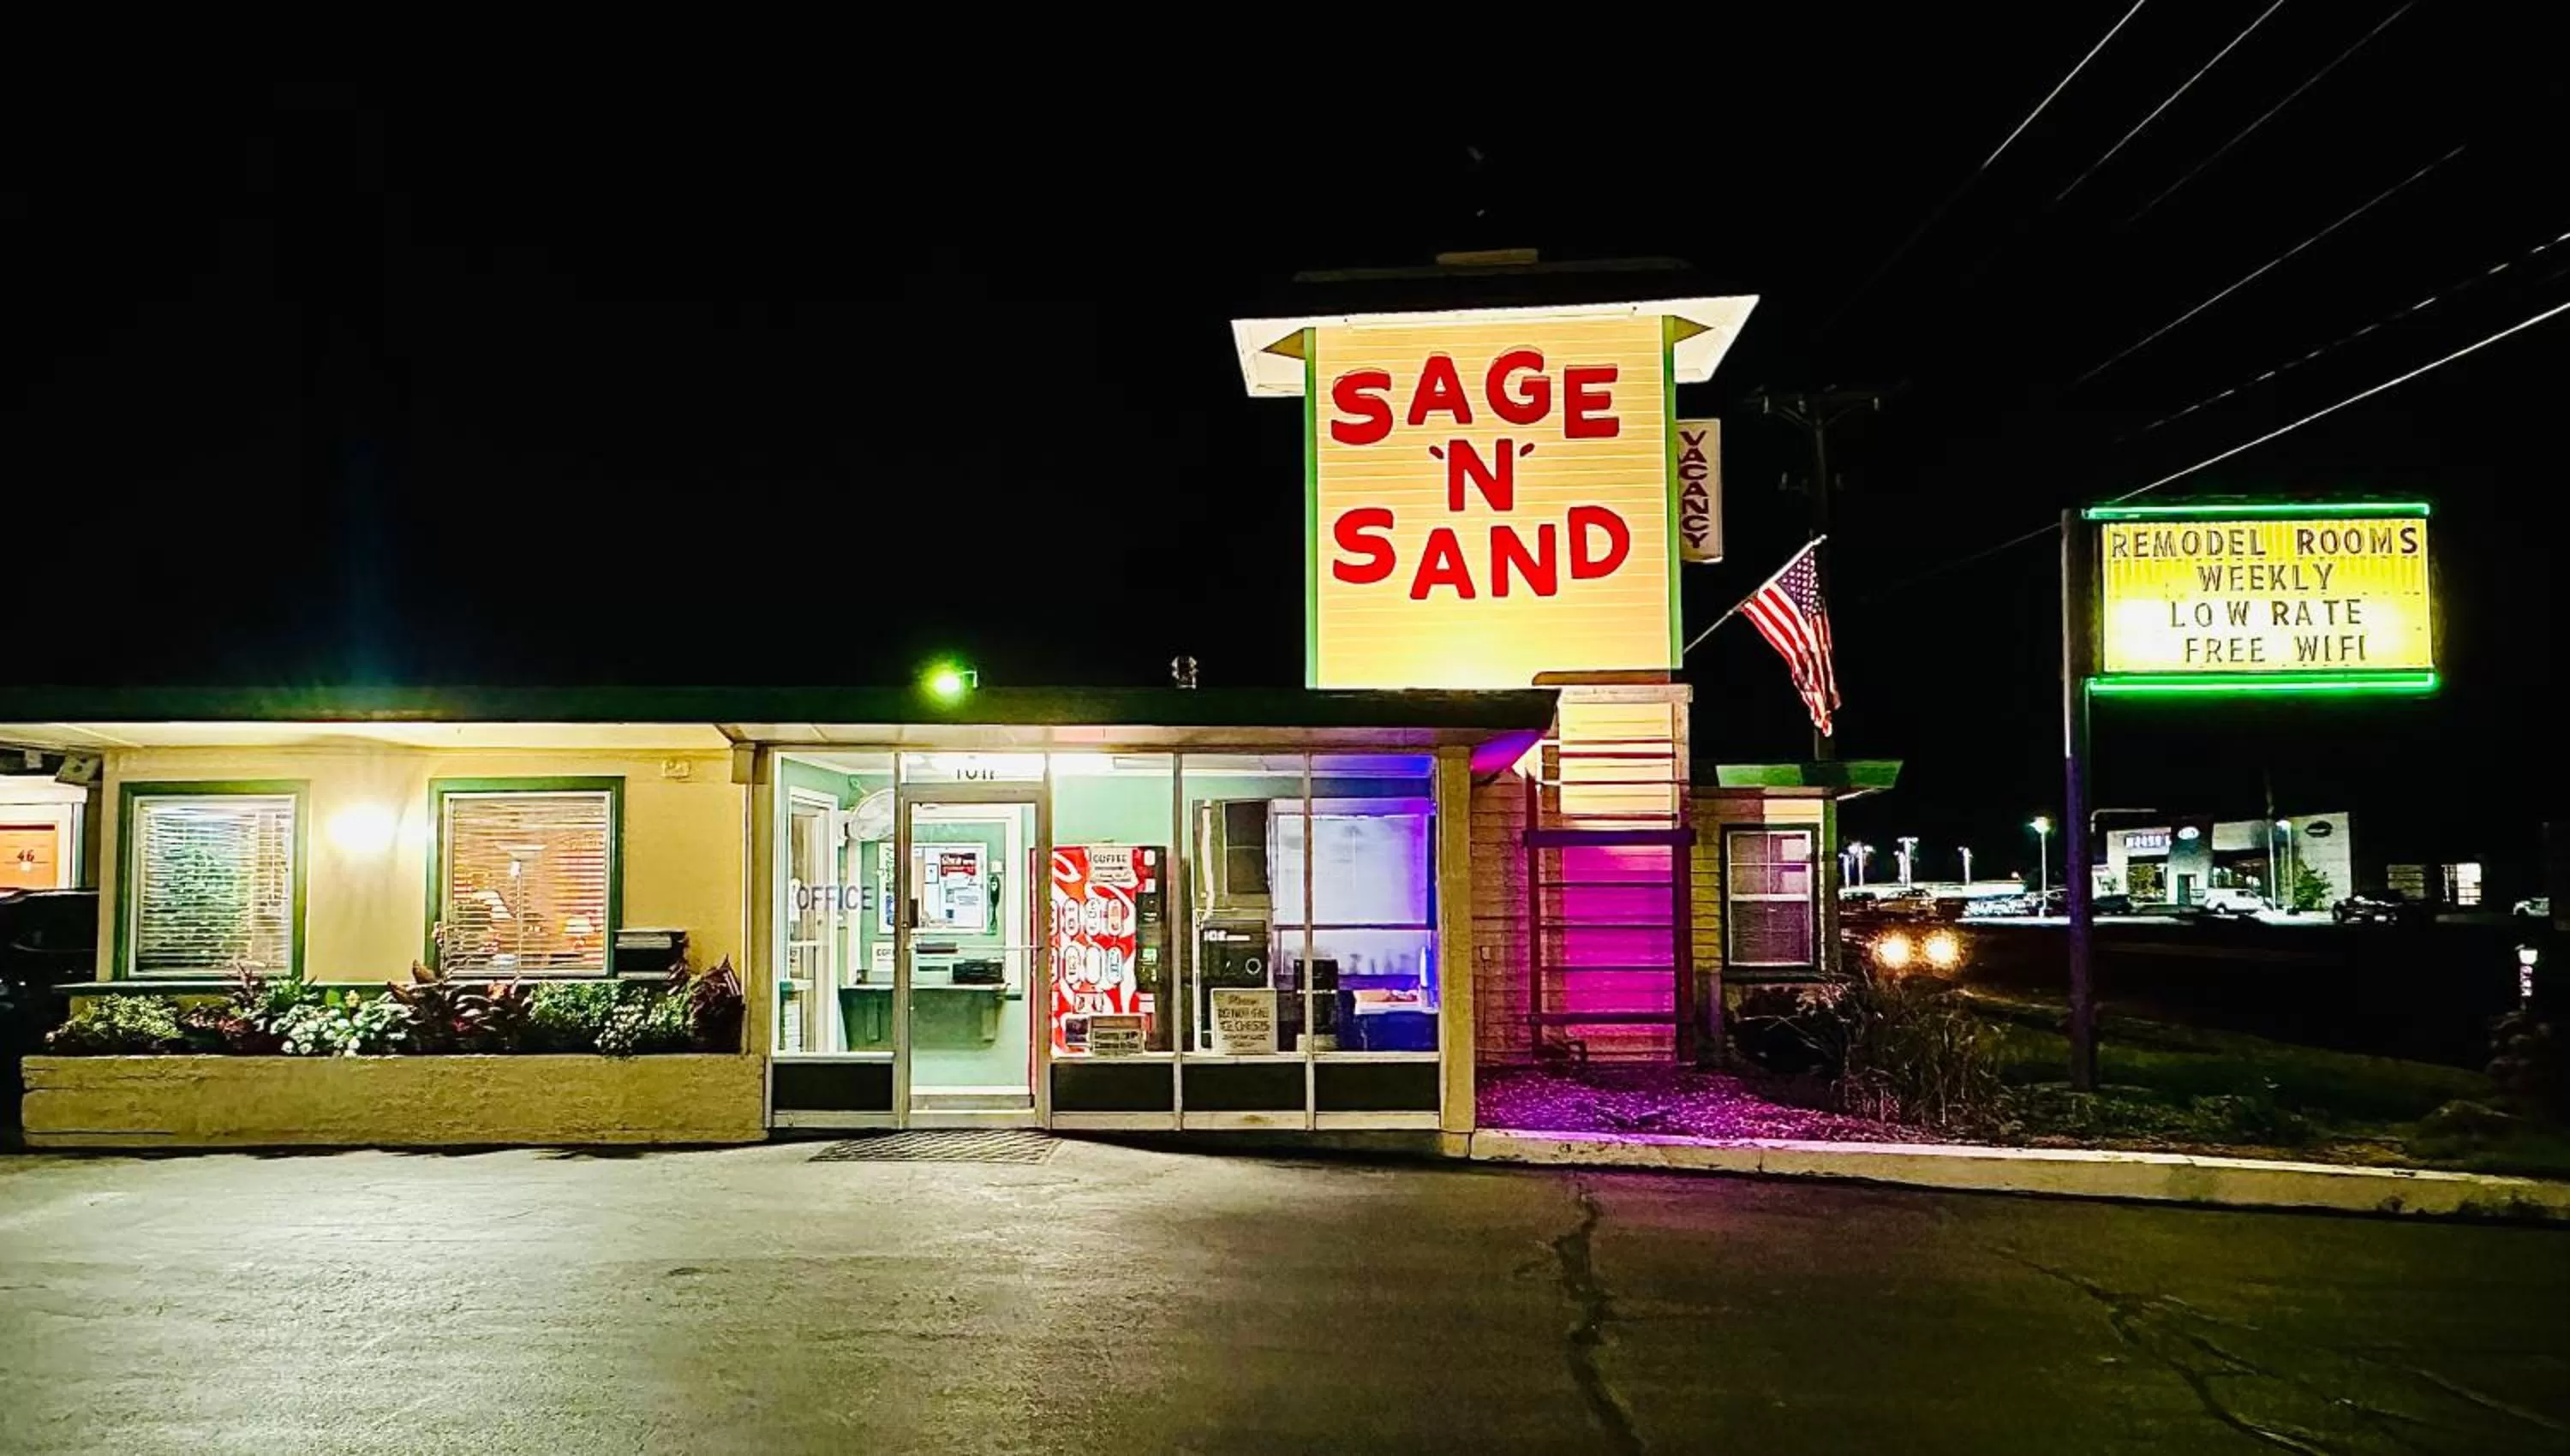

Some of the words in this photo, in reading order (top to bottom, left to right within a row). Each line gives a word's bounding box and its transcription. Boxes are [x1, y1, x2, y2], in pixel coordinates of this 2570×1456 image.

[1330, 345, 1620, 445] SAGE
[1679, 430, 1710, 549] VACANCY
[1332, 505, 1629, 600] SAND
[2111, 528, 2266, 558] REMODEL
[2297, 527, 2419, 557] ROOMS
[2197, 563, 2334, 593] WEEKLY
[2170, 600, 2250, 628] LOW
[2272, 599, 2362, 626] RATE
[2185, 636, 2266, 664] FREE
[2296, 635, 2366, 662] WIFI
[17, 850, 35, 862] 46
[797, 886, 873, 910] OFFICE
